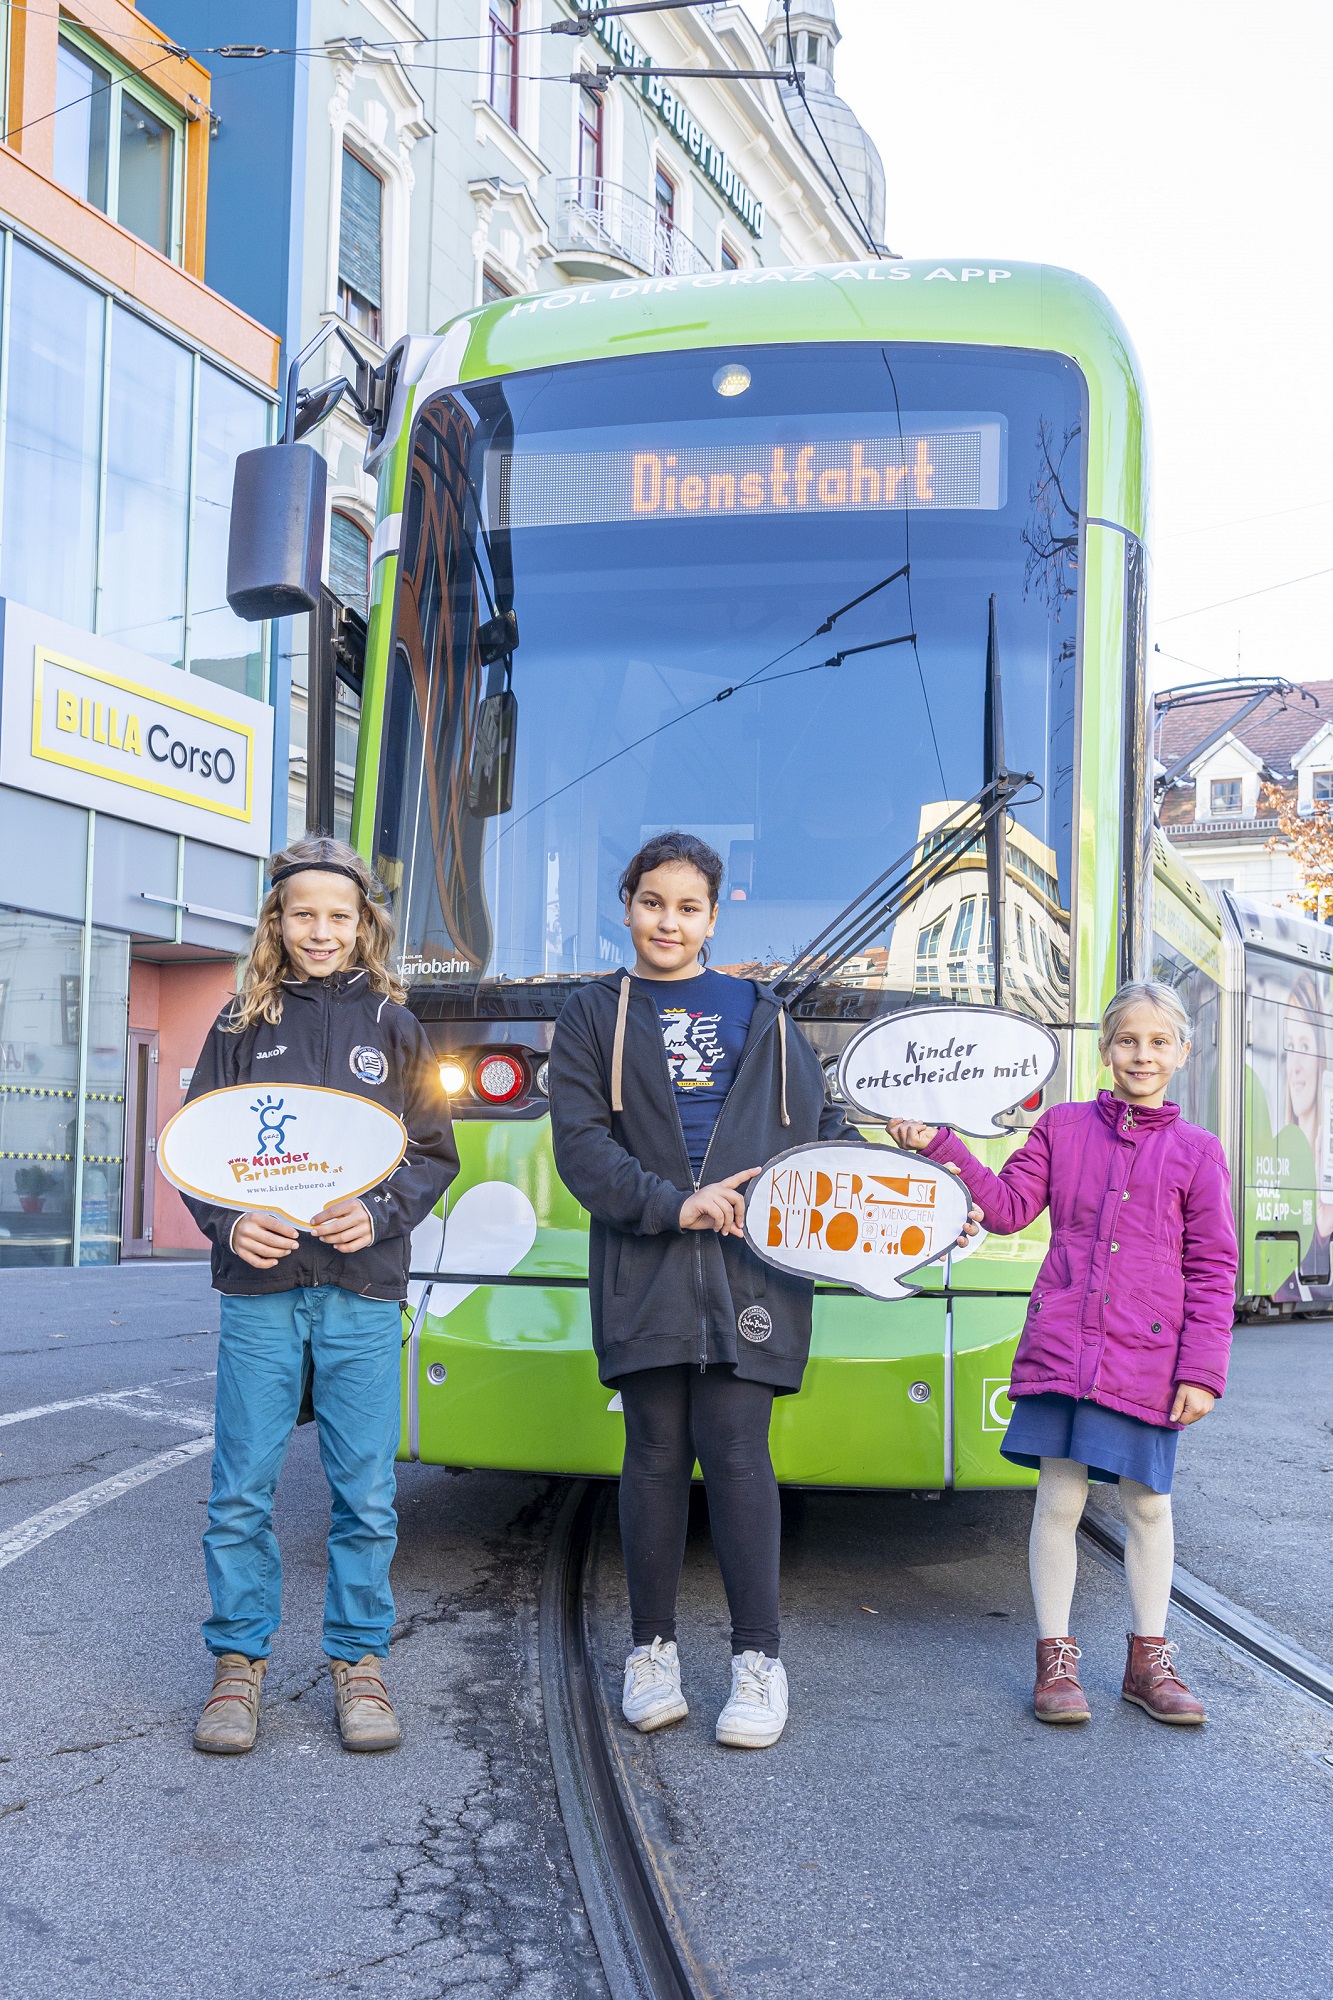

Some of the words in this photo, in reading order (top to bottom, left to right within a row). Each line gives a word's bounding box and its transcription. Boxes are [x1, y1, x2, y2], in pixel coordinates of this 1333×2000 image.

[644, 57, 766, 240] Bauernbund
[509, 291, 596, 318] HOL
[609, 279, 679, 299] DIR
[691, 268, 817, 288] GRAZ
[830, 267, 911, 281] ALS
[924, 267, 1012, 284] APP
[631, 439, 934, 513] Dienstfahrt
[56, 688, 142, 756] BILLA
[396, 958, 470, 975] variobahn
[256, 1049, 280, 1059] JAKO
[905, 1037, 978, 1064] Kinder
[855, 1060, 984, 1090] entscheiden
[993, 1054, 1038, 1079] mit!
[1255, 1156, 1274, 1176] HOL
[246, 1181, 336, 1194] www.kinderbuero.at
[770, 1168, 863, 1210] KINDER
[1255, 1179, 1280, 1199] GRAZ
[881, 1207, 935, 1222] MENSCHEN
[1255, 1202, 1272, 1221] ALS
[1273, 1202, 1290, 1221] APP
[766, 1206, 859, 1251] BÜRO
